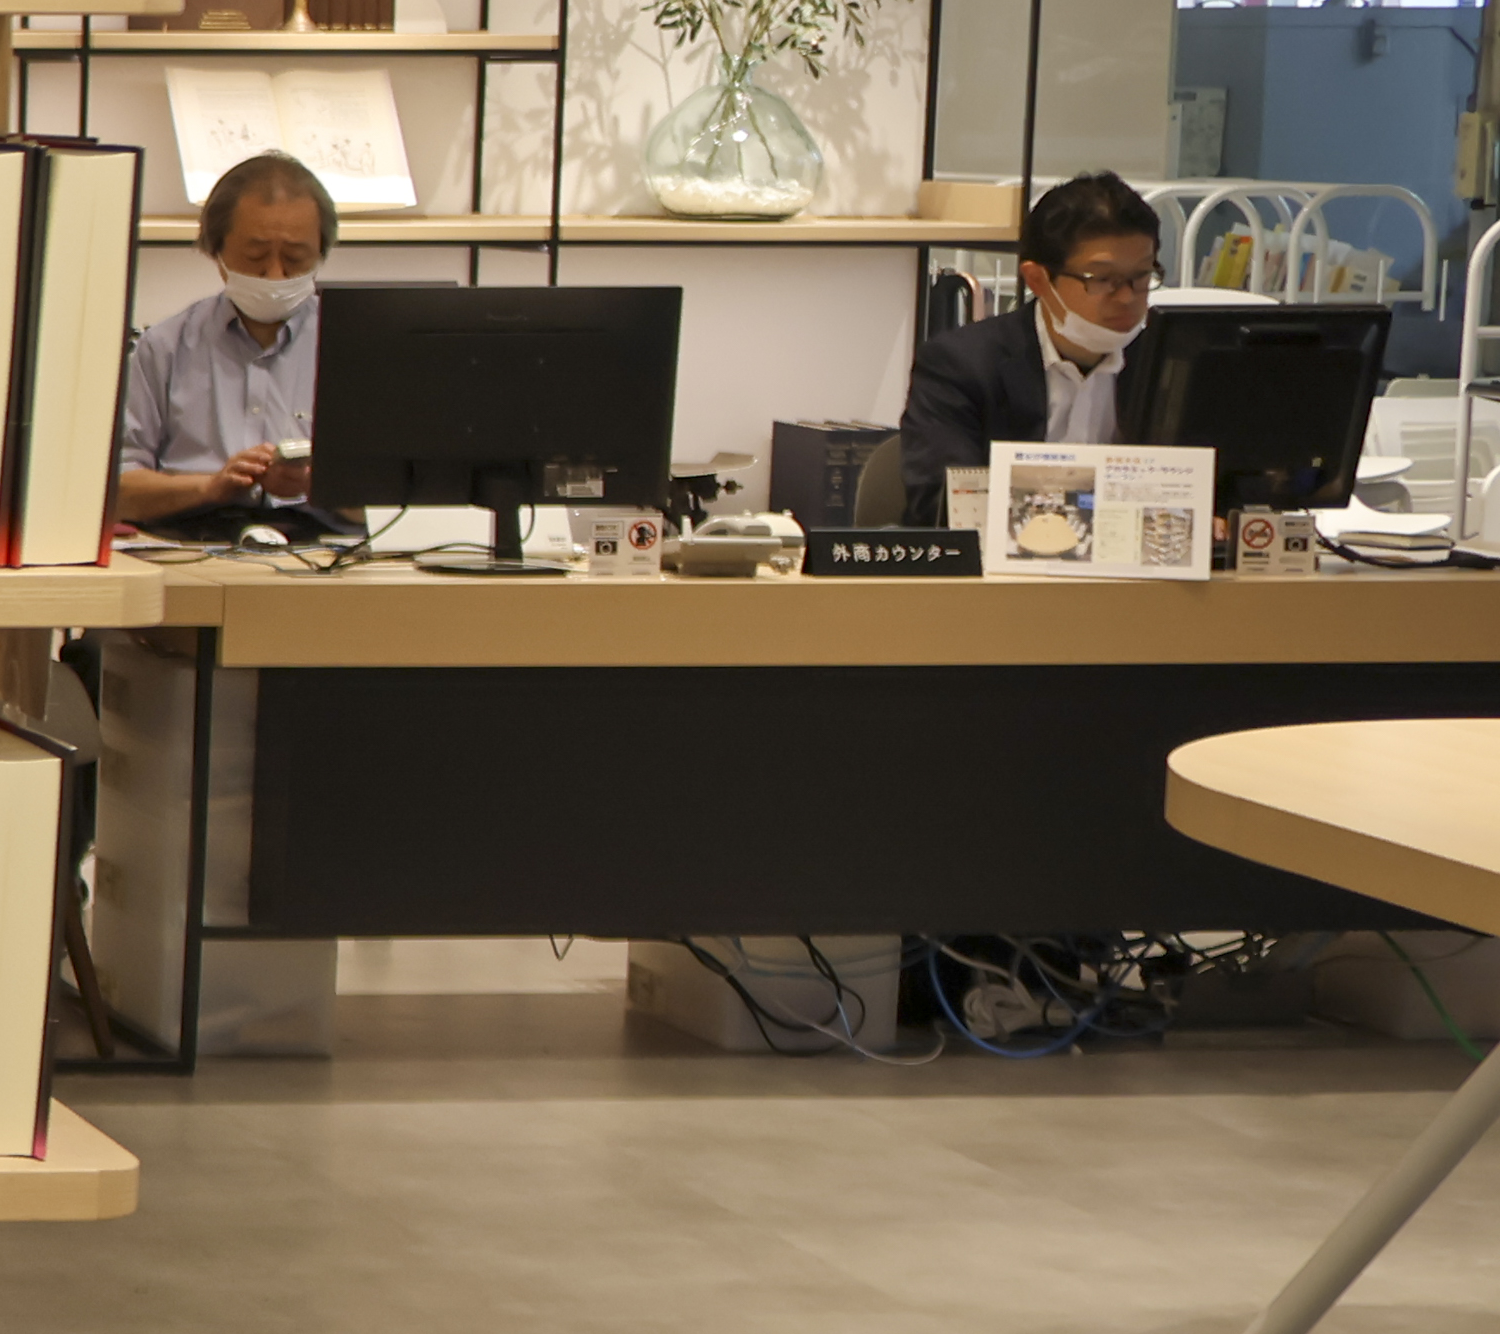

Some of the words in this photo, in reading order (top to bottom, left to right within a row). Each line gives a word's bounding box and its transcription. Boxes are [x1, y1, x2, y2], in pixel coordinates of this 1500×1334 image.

[831, 543, 962, 564] 外商カウンター
